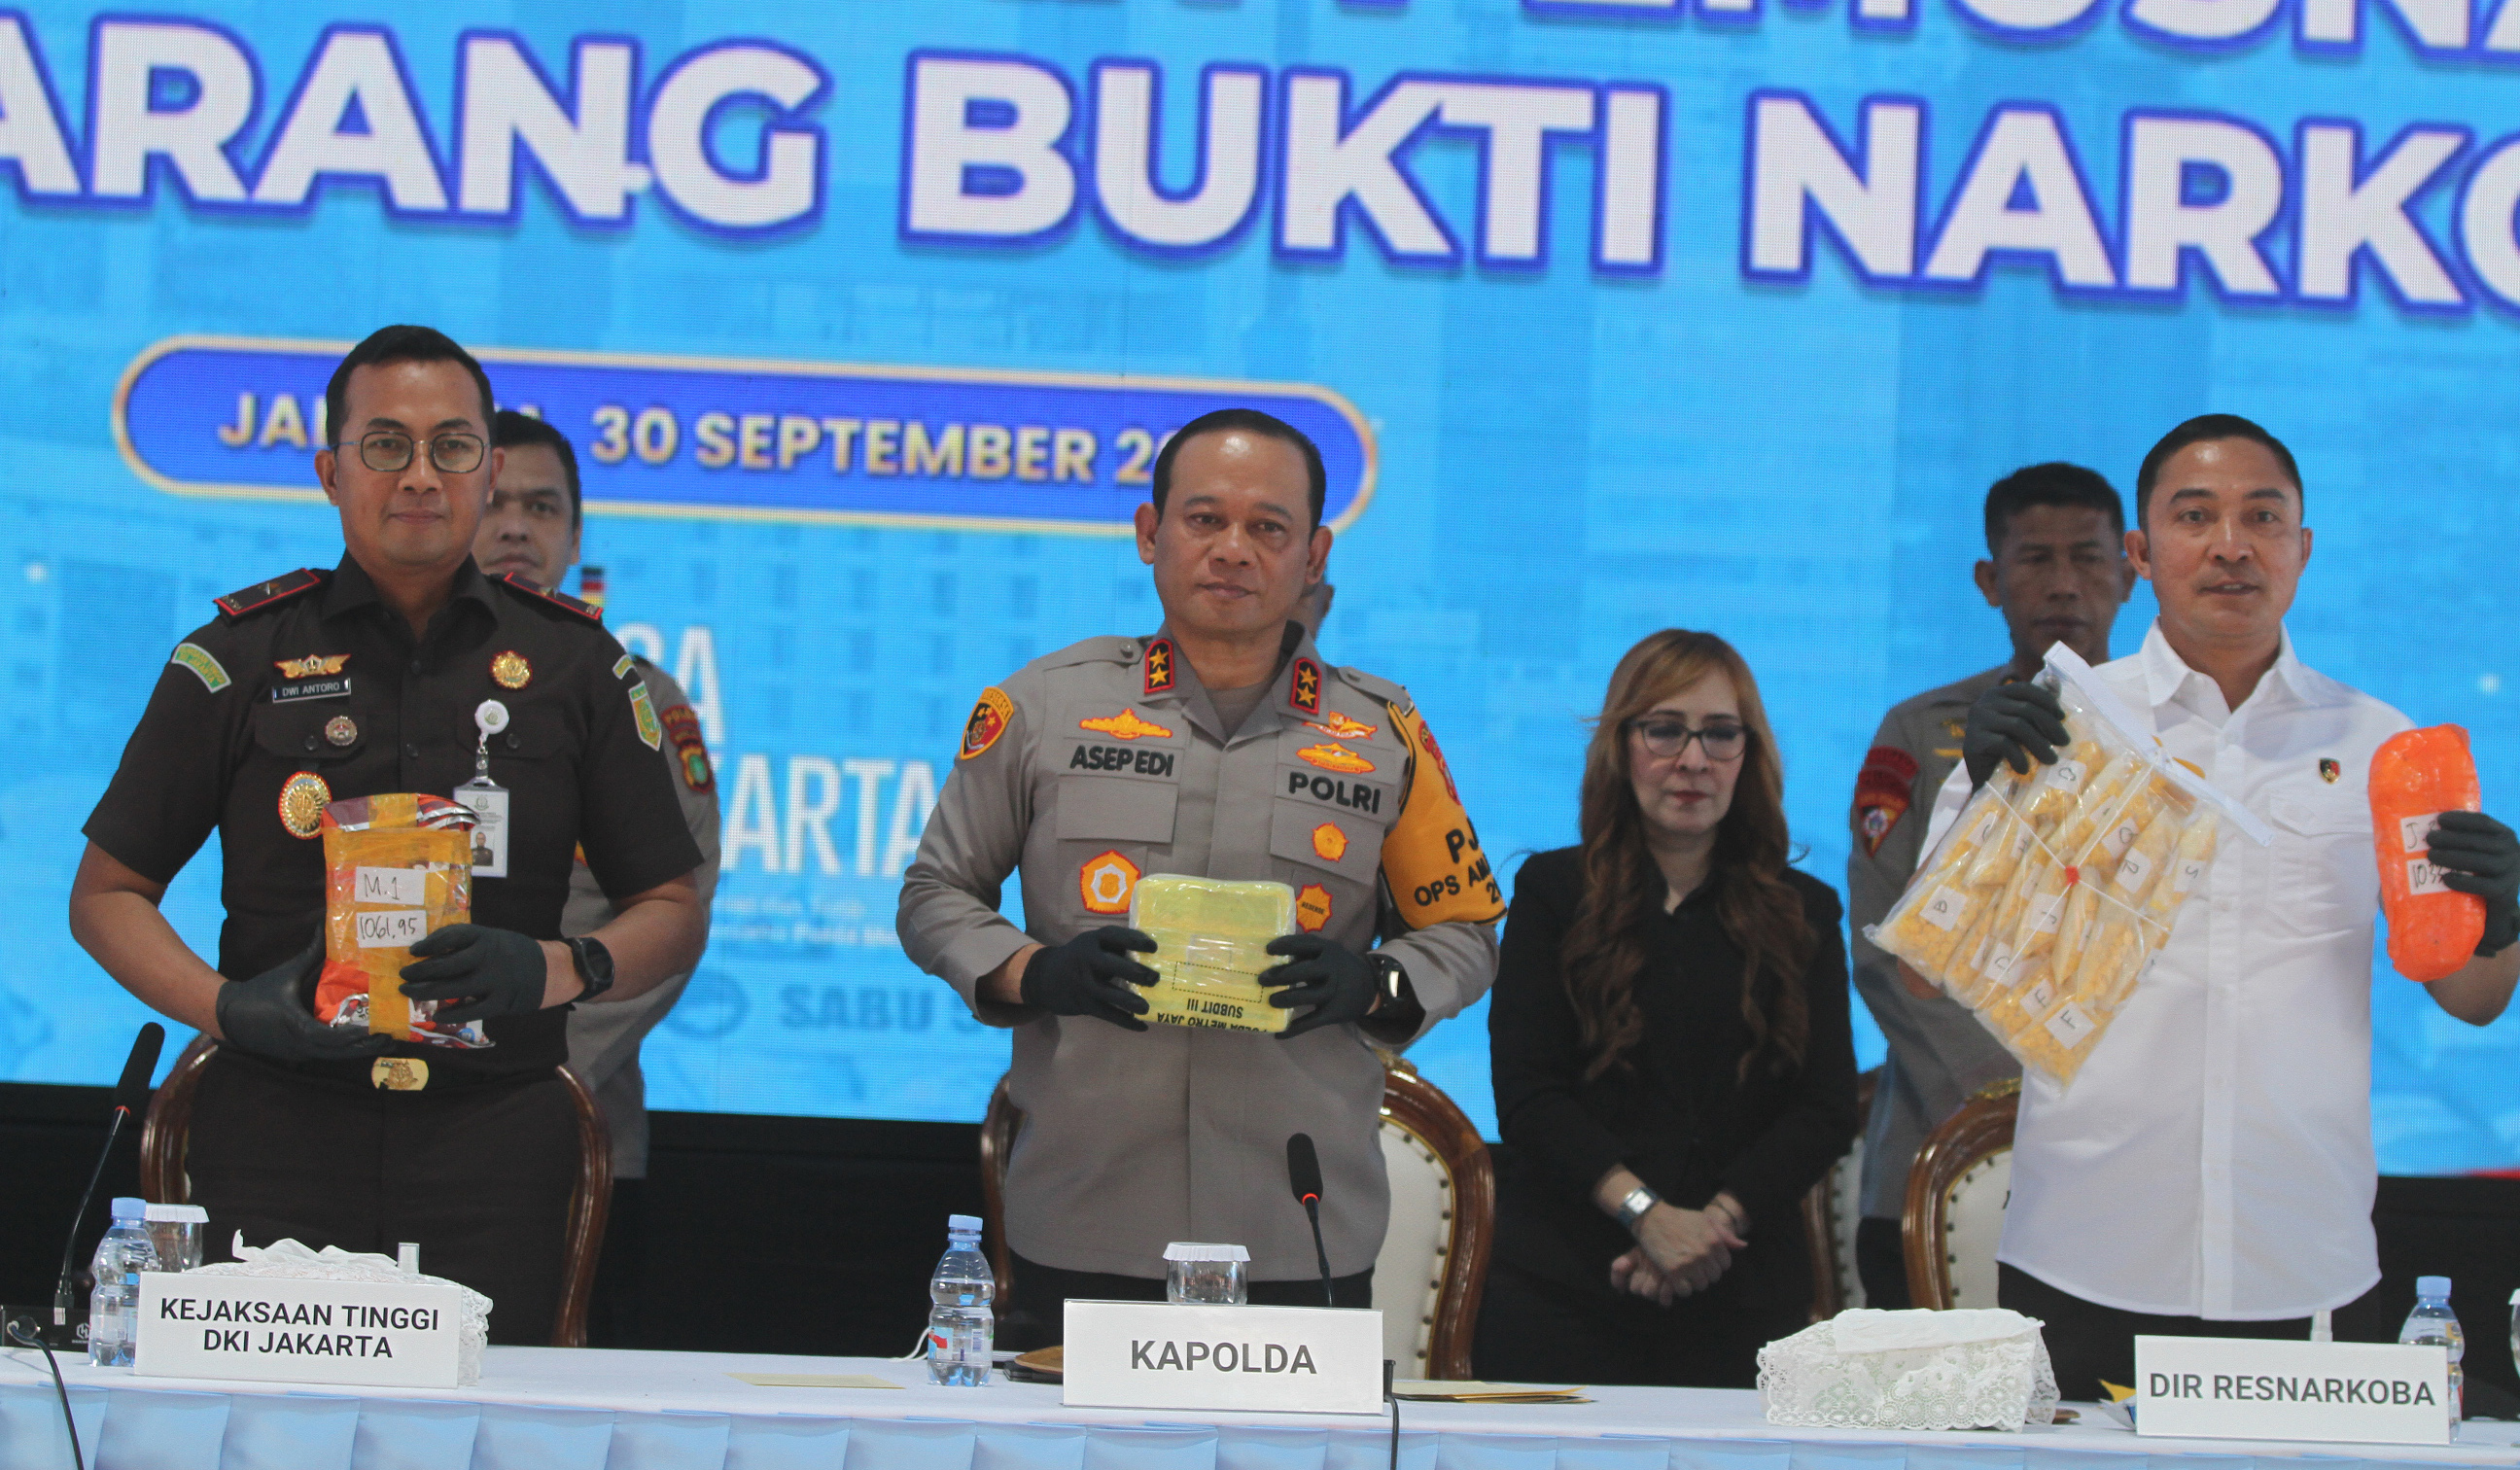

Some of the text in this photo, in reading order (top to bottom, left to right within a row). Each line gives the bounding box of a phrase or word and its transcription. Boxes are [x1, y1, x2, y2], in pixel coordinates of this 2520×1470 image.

[904, 54, 1666, 269] BUKTI
[591, 403, 680, 465] 30
[693, 412, 1098, 483] SEPTEMBER
[282, 682, 340, 697] DWI ANTORO
[1068, 744, 1175, 778] ASEP EDI
[1288, 771, 1382, 815] POLRI
[710, 752, 939, 879] ARTA
[1414, 874, 1461, 907] OPS
[1157, 1012, 1184, 1025] JAYA
[1201, 999, 1243, 1019] SUBDIT
[159, 1297, 440, 1332] KEJAKSAAN TINGGI
[203, 1328, 394, 1359] DKI JAKARTA
[1130, 1339, 1317, 1376] KAPOLDA
[2149, 1372, 2436, 1408] DIR RESNARKOBA
